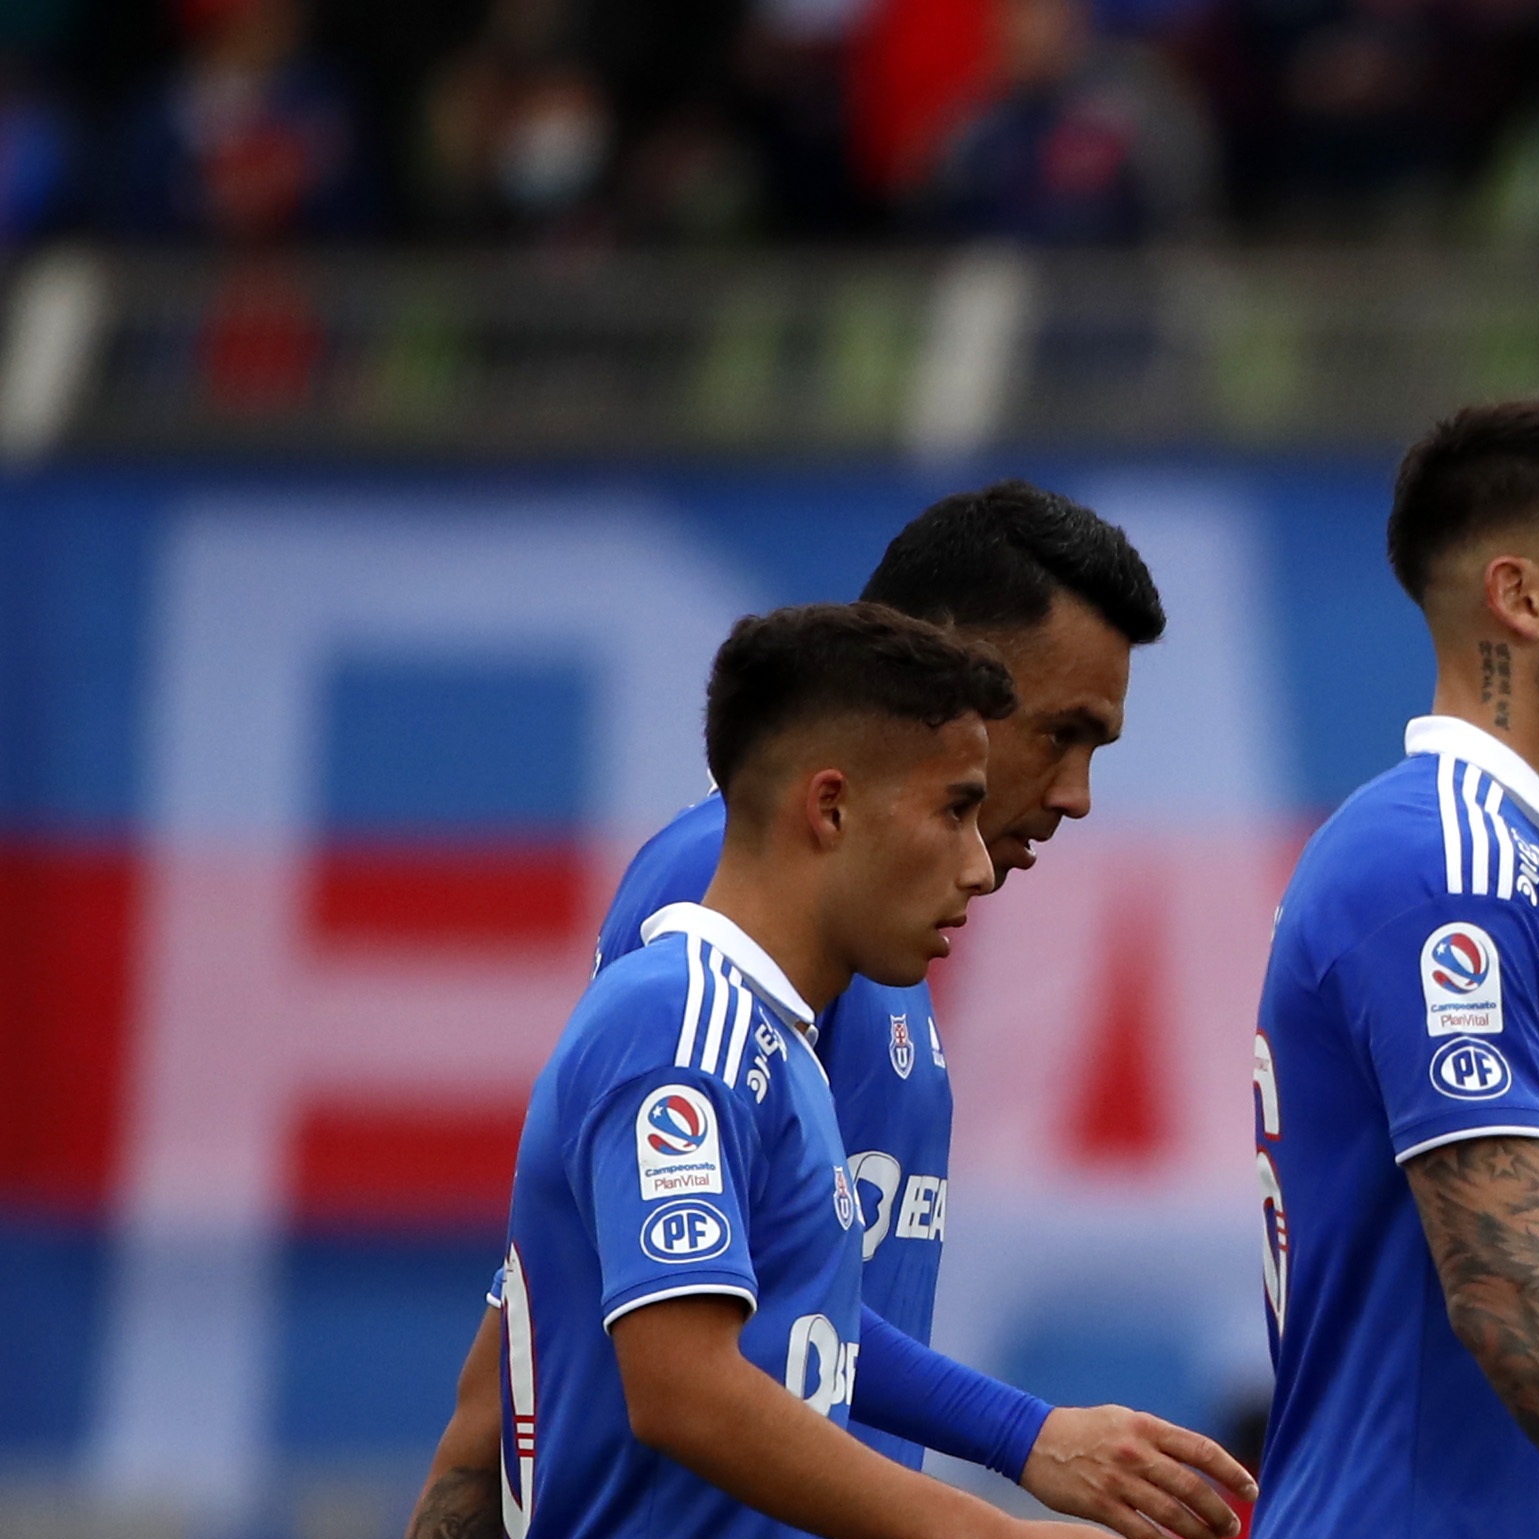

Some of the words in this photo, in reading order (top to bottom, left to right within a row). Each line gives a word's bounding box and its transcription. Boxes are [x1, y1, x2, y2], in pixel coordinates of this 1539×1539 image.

[1431, 1000, 1497, 1013] Campeonato
[1441, 1013, 1489, 1027] PlanVital
[1452, 1049, 1493, 1087] PF
[645, 1161, 716, 1177] Campeonato
[654, 1173, 710, 1191] PlanVital
[662, 1212, 708, 1250] PF
